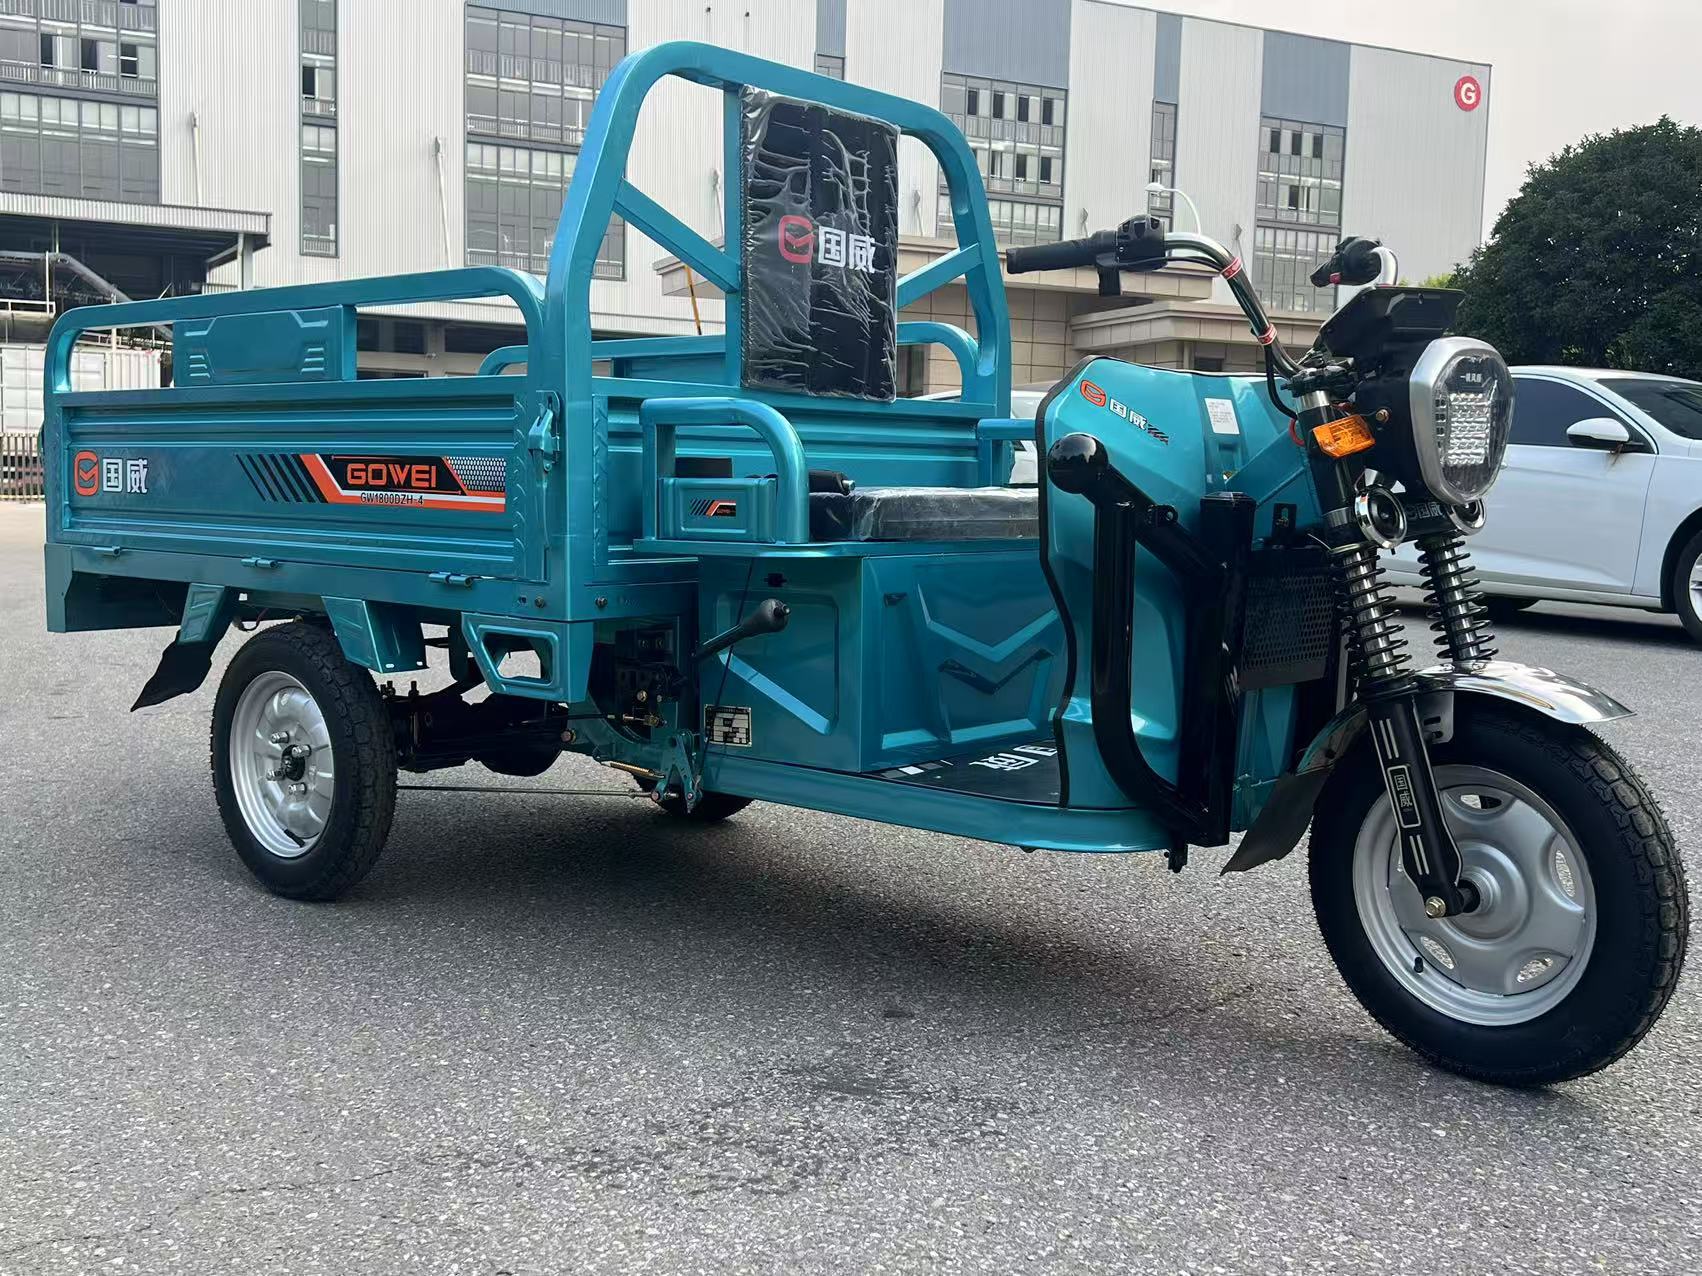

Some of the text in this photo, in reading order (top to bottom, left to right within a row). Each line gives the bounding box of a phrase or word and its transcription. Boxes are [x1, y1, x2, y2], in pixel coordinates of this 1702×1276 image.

[1461, 82, 1476, 105] G
[818, 225, 876, 274] 国威
[1109, 397, 1147, 431] 国威
[102, 457, 149, 494] 国威
[347, 463, 437, 488] GOWEI
[360, 492, 424, 505] GW1800DZH-4
[1394, 774, 1413, 808] 国威
